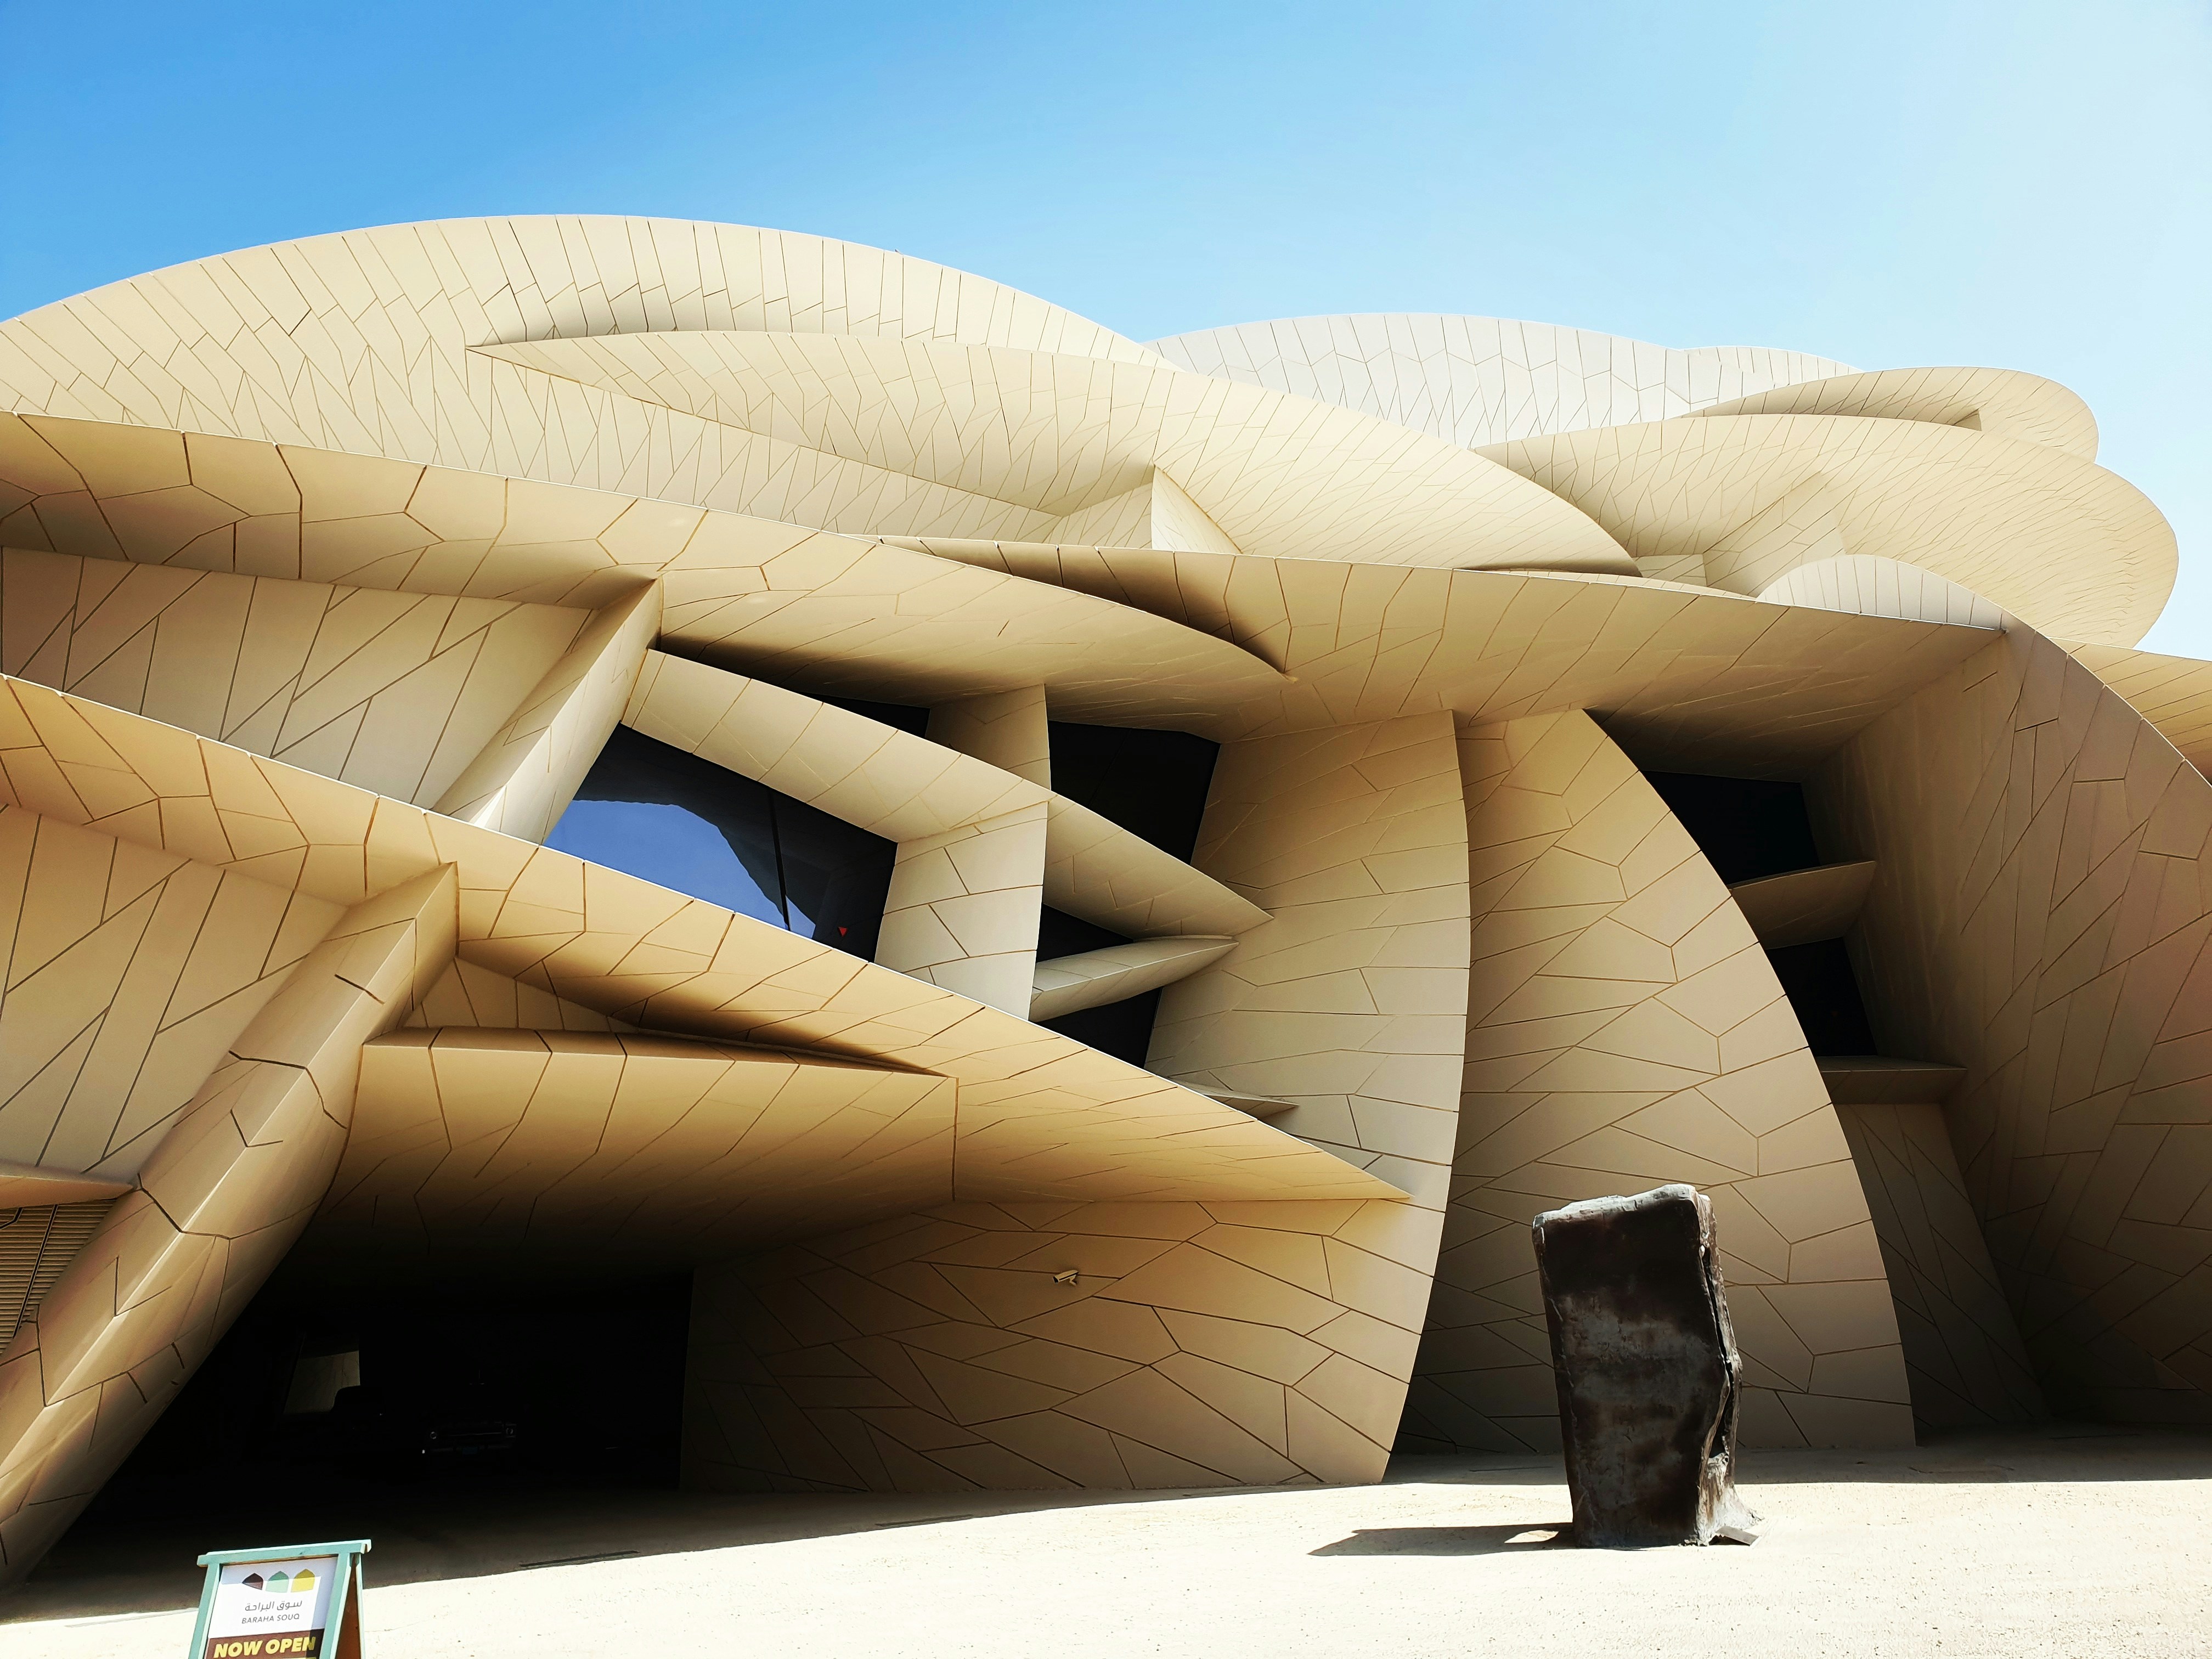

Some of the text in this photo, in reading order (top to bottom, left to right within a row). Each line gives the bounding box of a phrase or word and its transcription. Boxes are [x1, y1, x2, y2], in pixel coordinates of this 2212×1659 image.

[245, 1600, 302, 1612] سوق البراحة
[241, 1613, 300, 1624] BARAHA SOUQ
[213, 1637, 316, 1658] NOW OPEN
